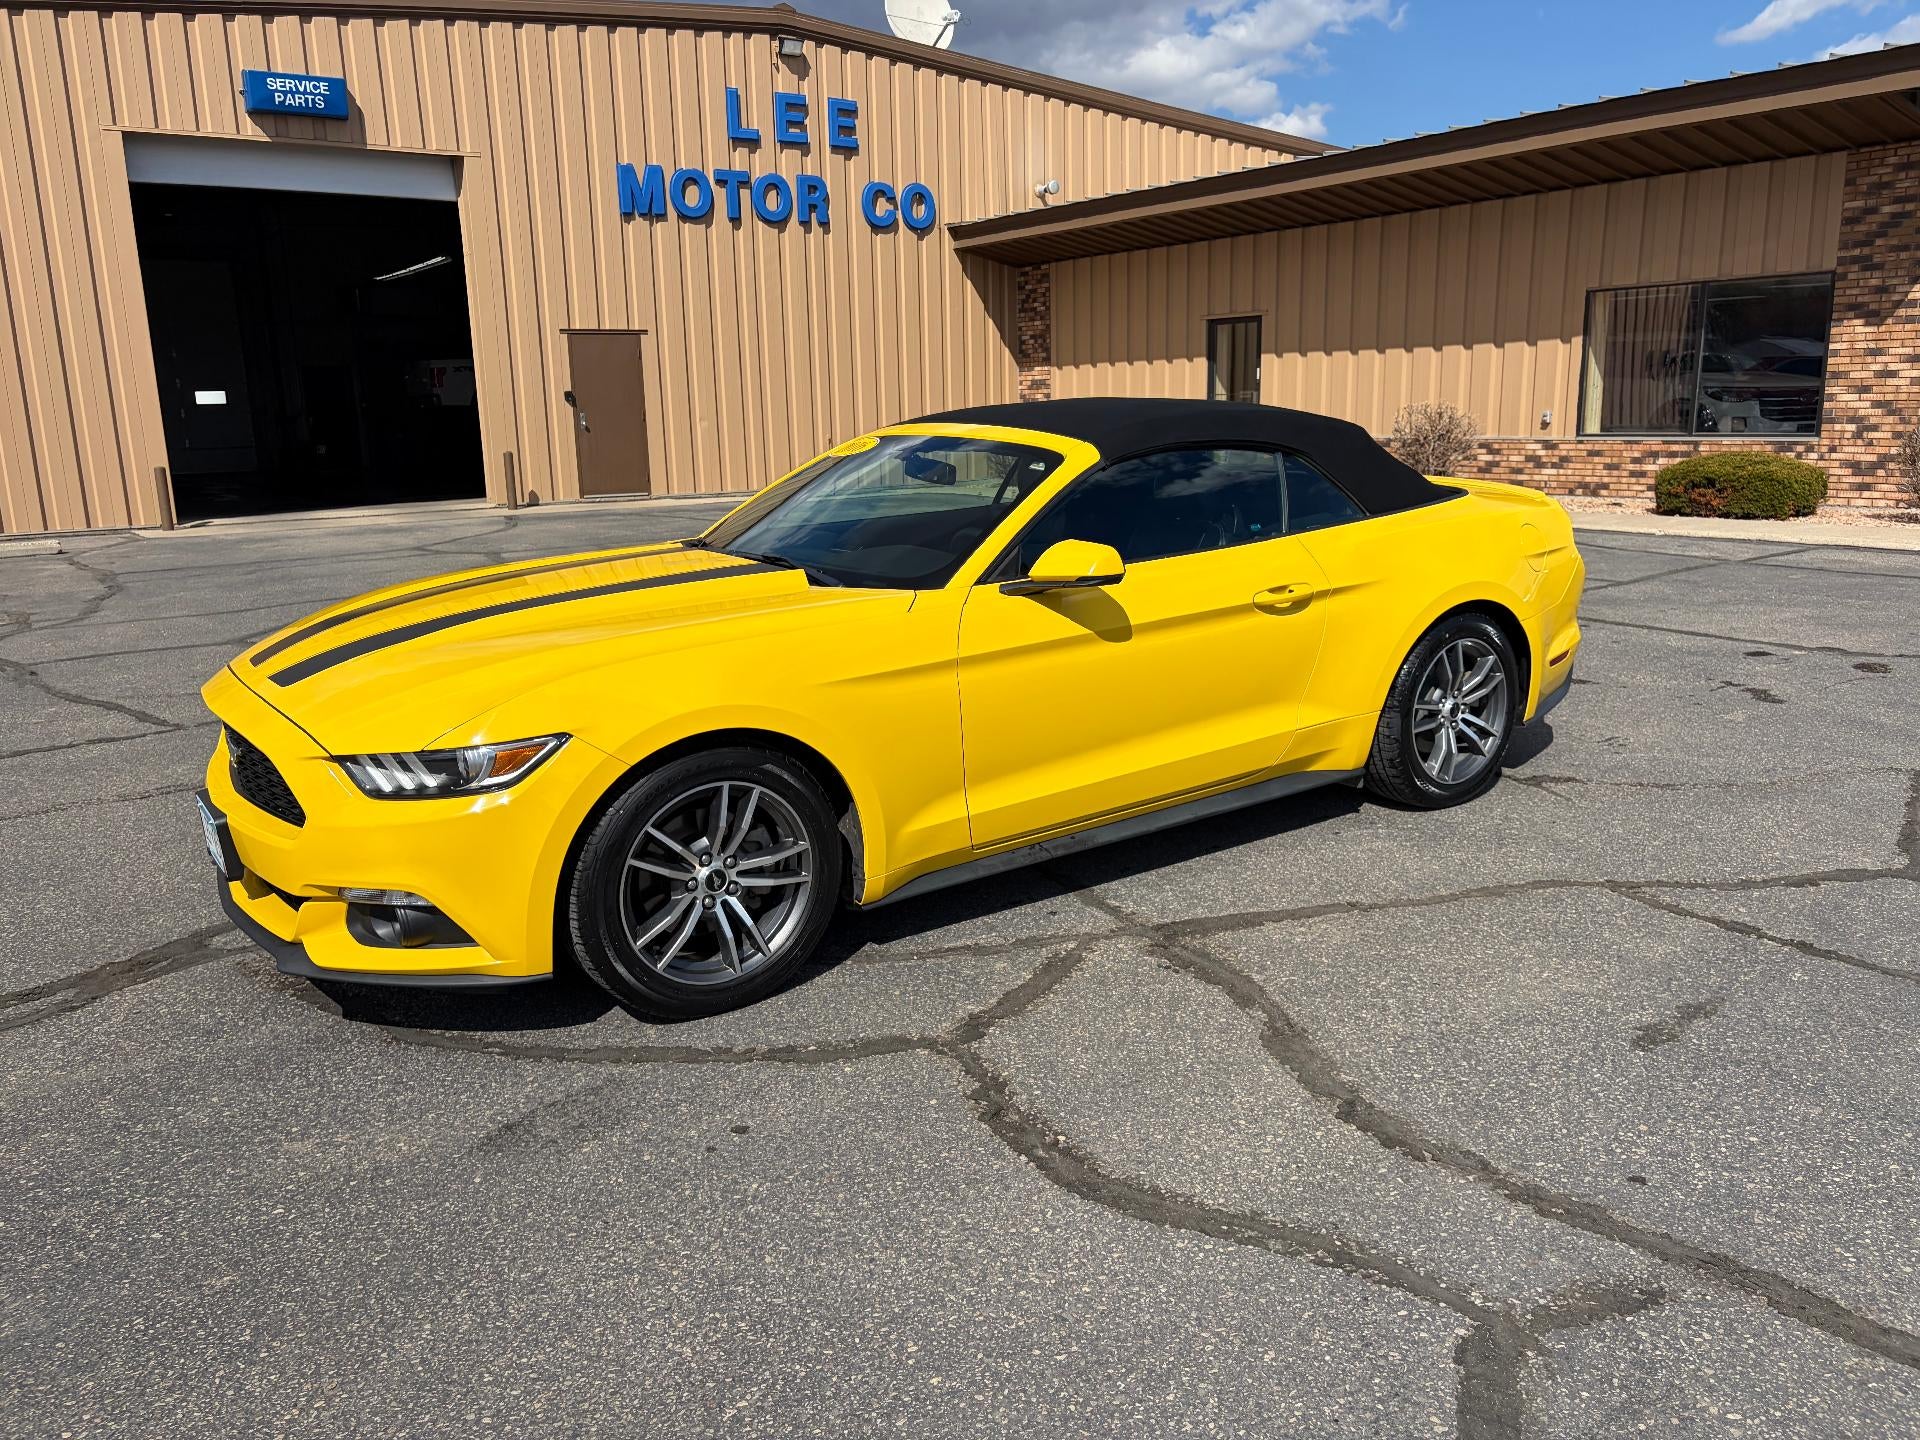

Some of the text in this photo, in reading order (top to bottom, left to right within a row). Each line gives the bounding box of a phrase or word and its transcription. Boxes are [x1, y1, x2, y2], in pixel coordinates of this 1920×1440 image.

[266, 78, 329, 94] SERVICE
[275, 93, 325, 108] PARTS
[725, 86, 859, 150] LEE
[616, 162, 936, 230] MOTOR CO
